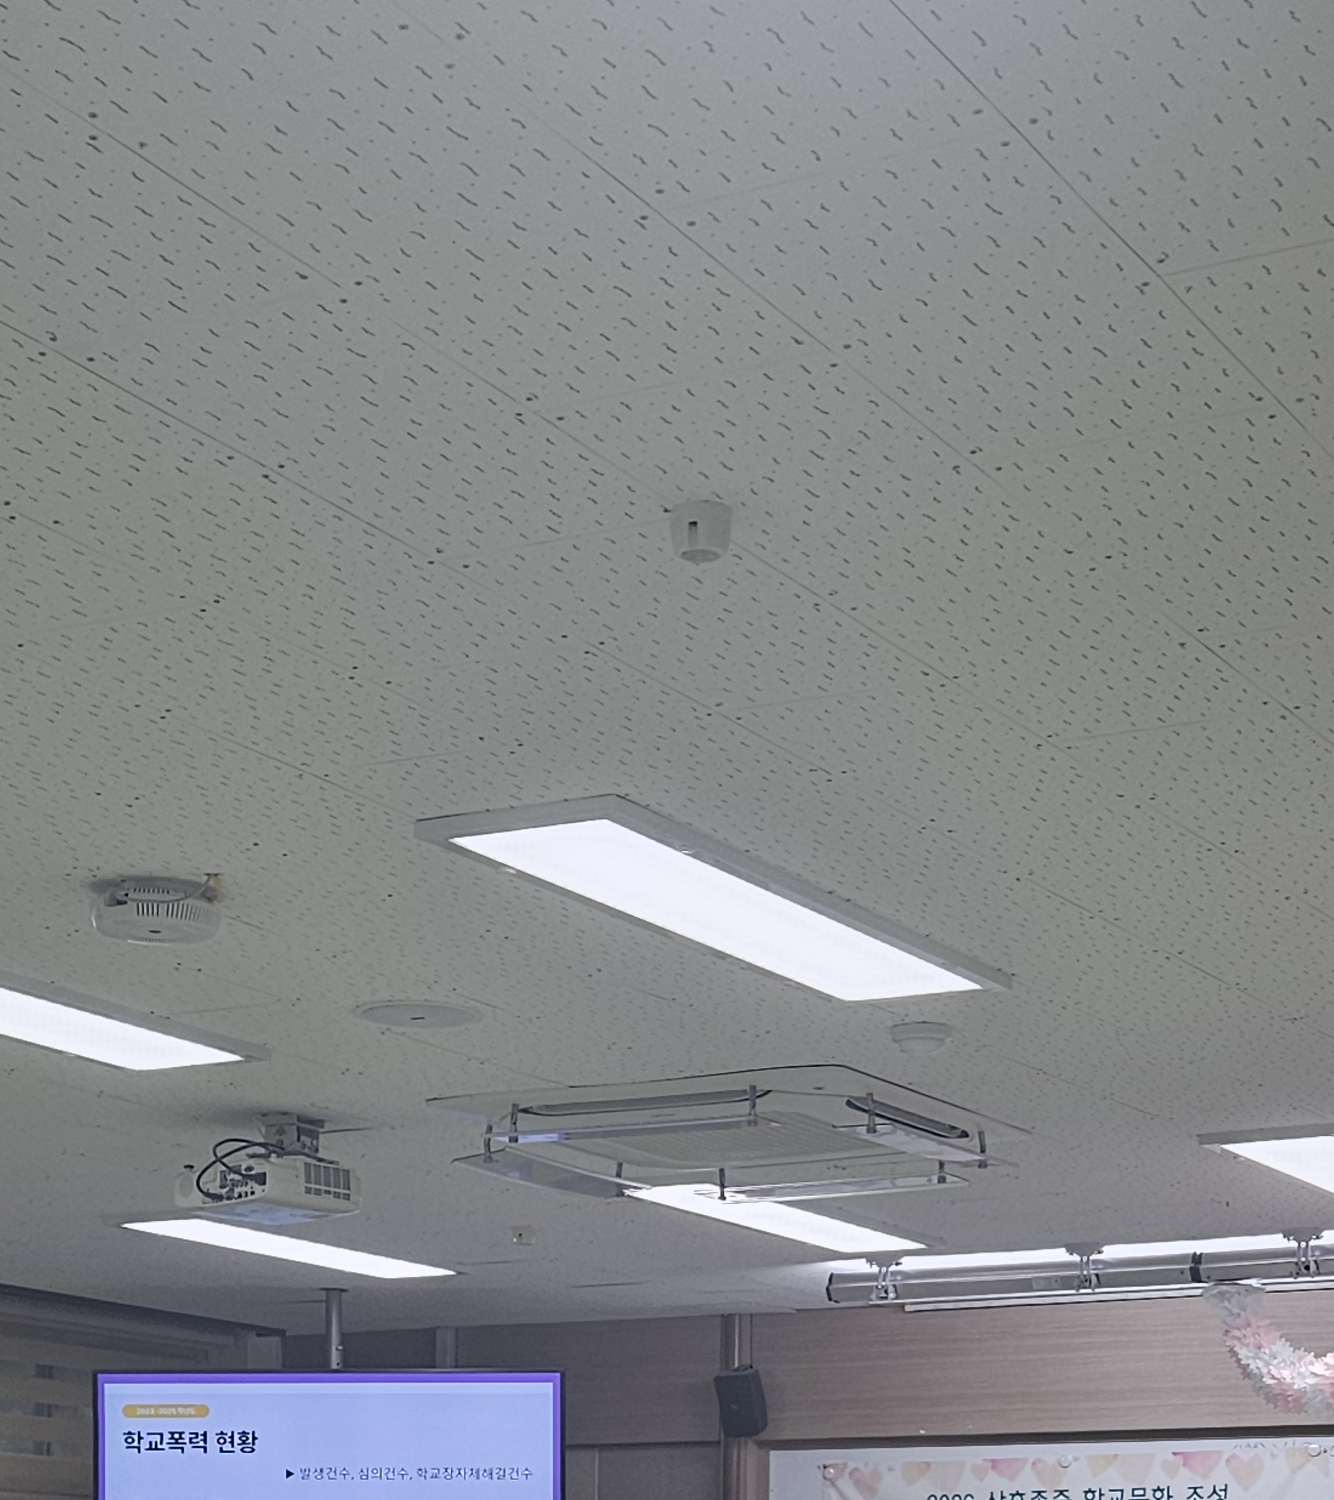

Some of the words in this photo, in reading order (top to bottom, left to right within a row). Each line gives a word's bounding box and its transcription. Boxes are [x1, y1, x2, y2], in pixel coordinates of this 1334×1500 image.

[122, 1430, 208, 1454] 학교폭력
[215, 1430, 259, 1454] 현황
[299, 1467, 354, 1481] 발생건수,
[359, 1467, 413, 1481] 심의건수,
